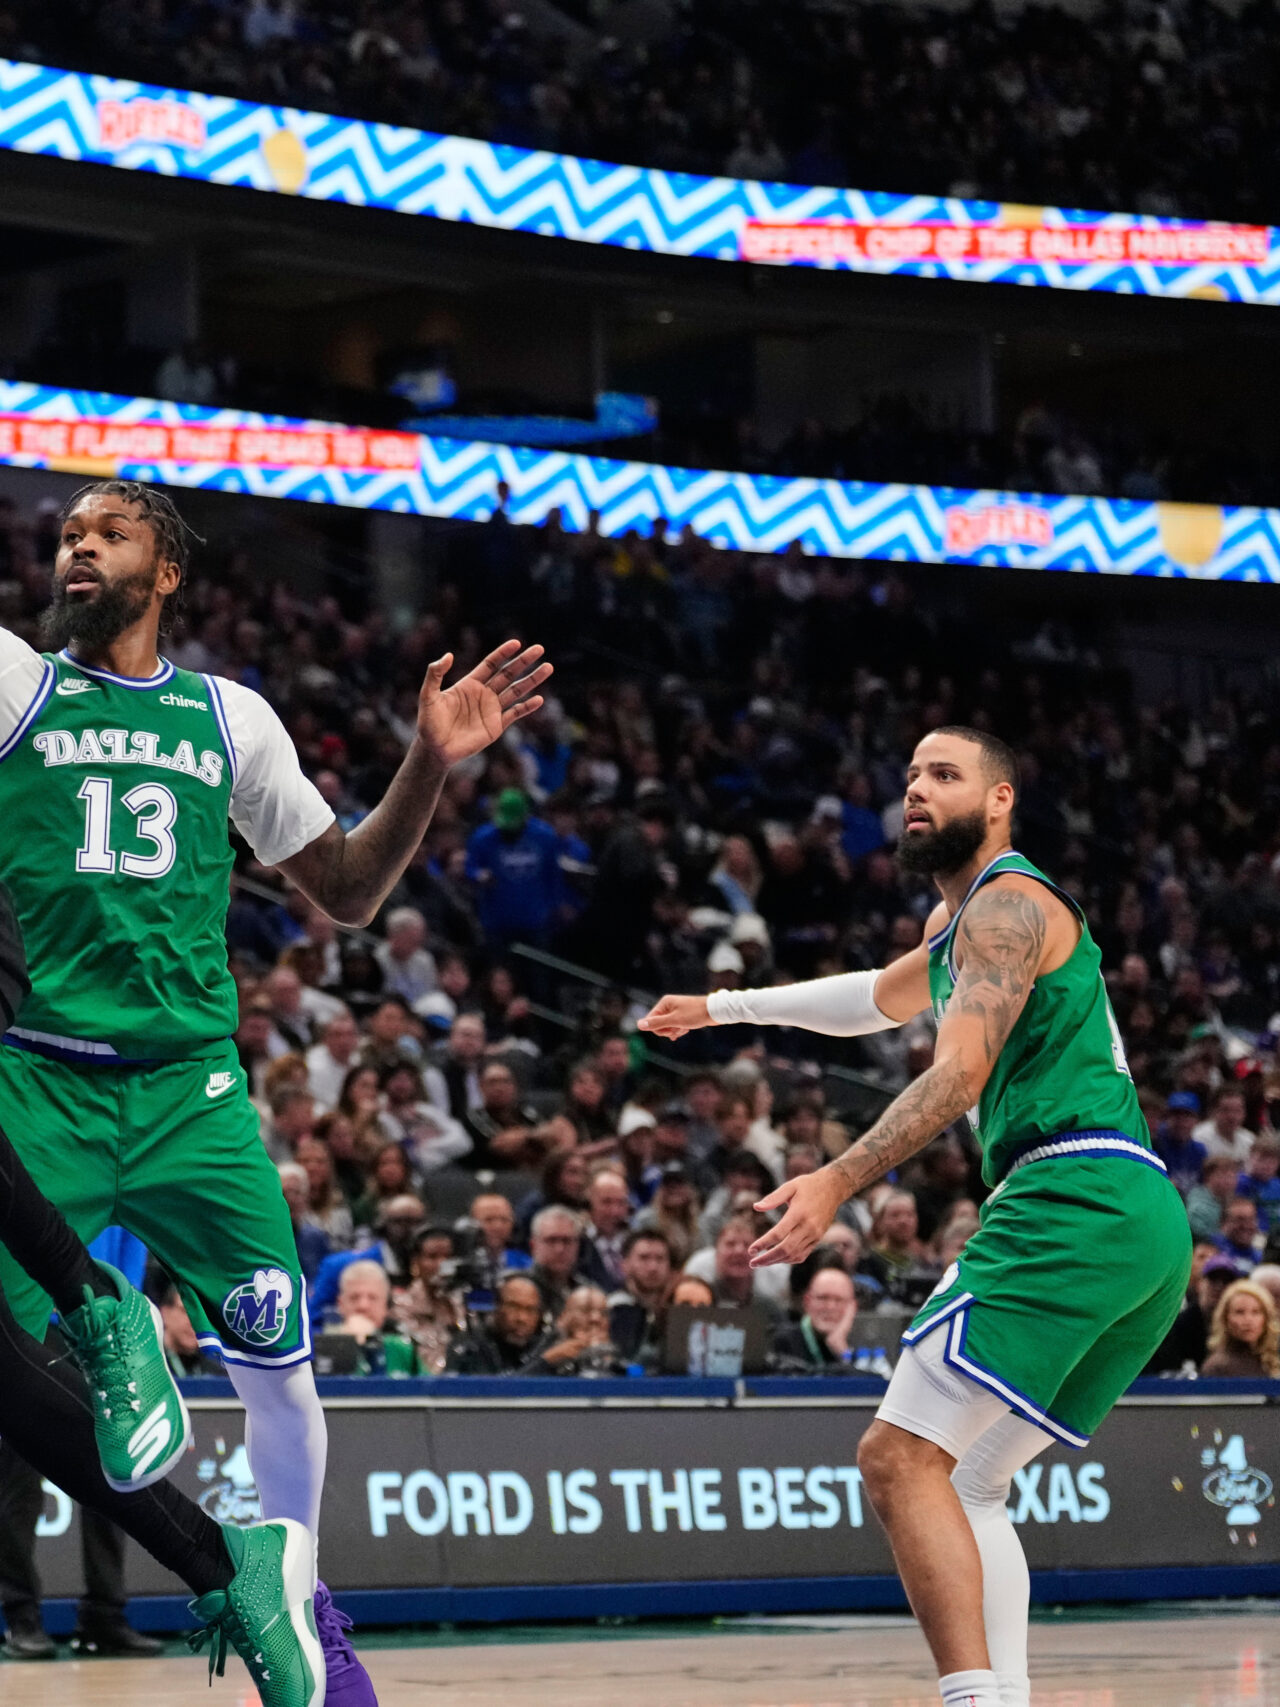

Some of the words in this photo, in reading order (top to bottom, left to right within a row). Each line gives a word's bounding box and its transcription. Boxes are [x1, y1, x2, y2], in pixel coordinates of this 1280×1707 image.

[935, 228, 972, 258] OF
[979, 229, 1028, 258] THE
[1031, 230, 1124, 260] DALLAS
[1129, 230, 1267, 262] MAVERICKS
[21, 422, 68, 456] THE
[72, 424, 167, 459] FLAVOR
[173, 427, 232, 461] THAT
[237, 430, 328, 466] SPEAKS
[332, 434, 366, 467] TO
[370, 435, 418, 470] YOU
[159, 692, 209, 711] chime
[33, 729, 224, 787] DALLAS
[75, 776, 178, 879] 13
[366, 1469, 534, 1537] FORD
[546, 1467, 603, 1535] IS
[609, 1468, 728, 1533] THE
[737, 1466, 865, 1531] BEST
[1006, 1462, 1120, 1524] XAS
